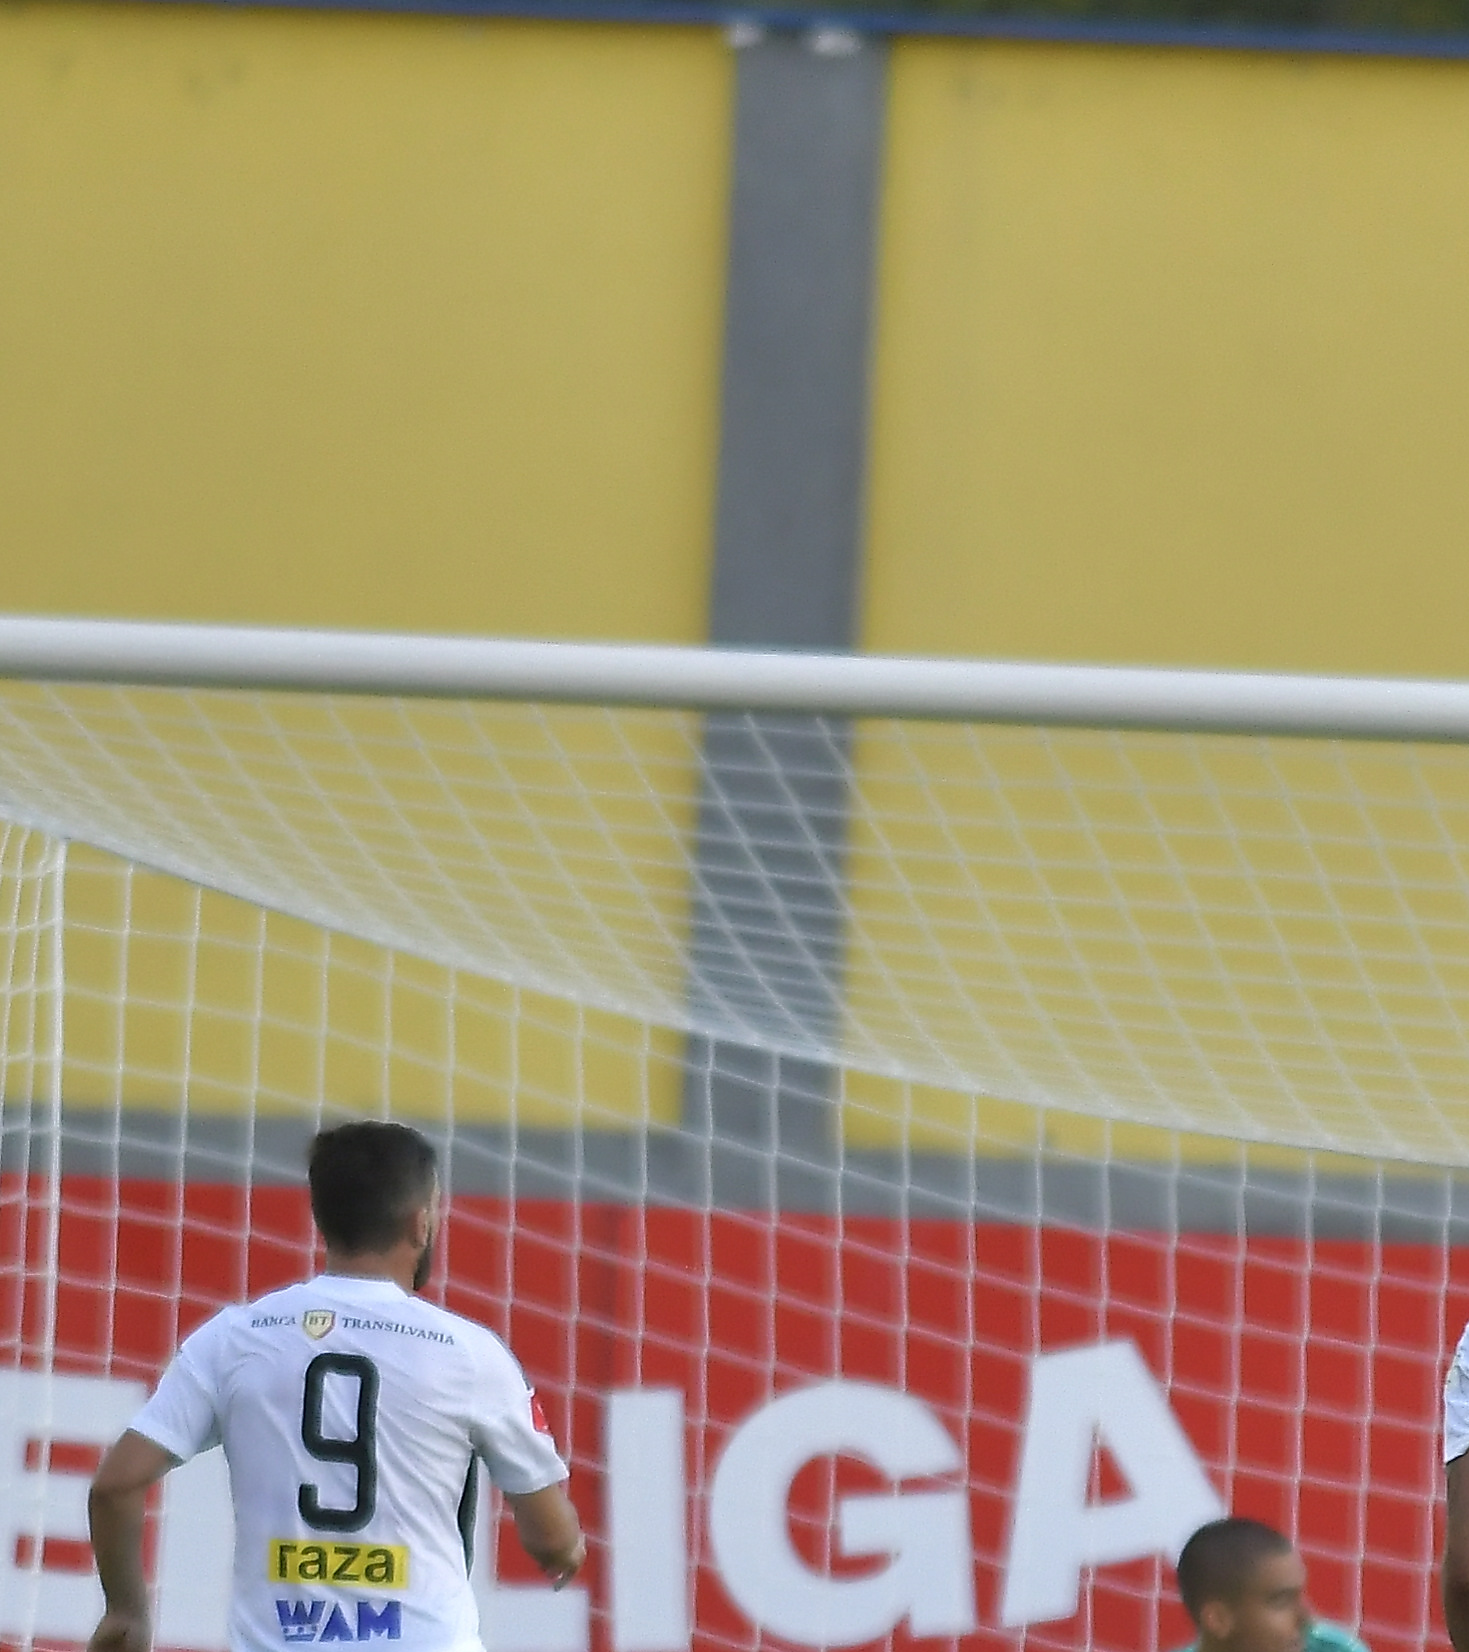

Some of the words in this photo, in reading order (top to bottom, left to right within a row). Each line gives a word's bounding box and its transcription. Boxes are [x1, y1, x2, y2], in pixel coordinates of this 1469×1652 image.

[251, 1316, 297, 1329] BANCA
[309, 1315, 328, 1326] BT
[341, 1316, 455, 1345] TRANSILVANIA
[298, 1352, 380, 1533] 9
[279, 1544, 395, 1583] raza
[276, 1600, 401, 1641] WAM
